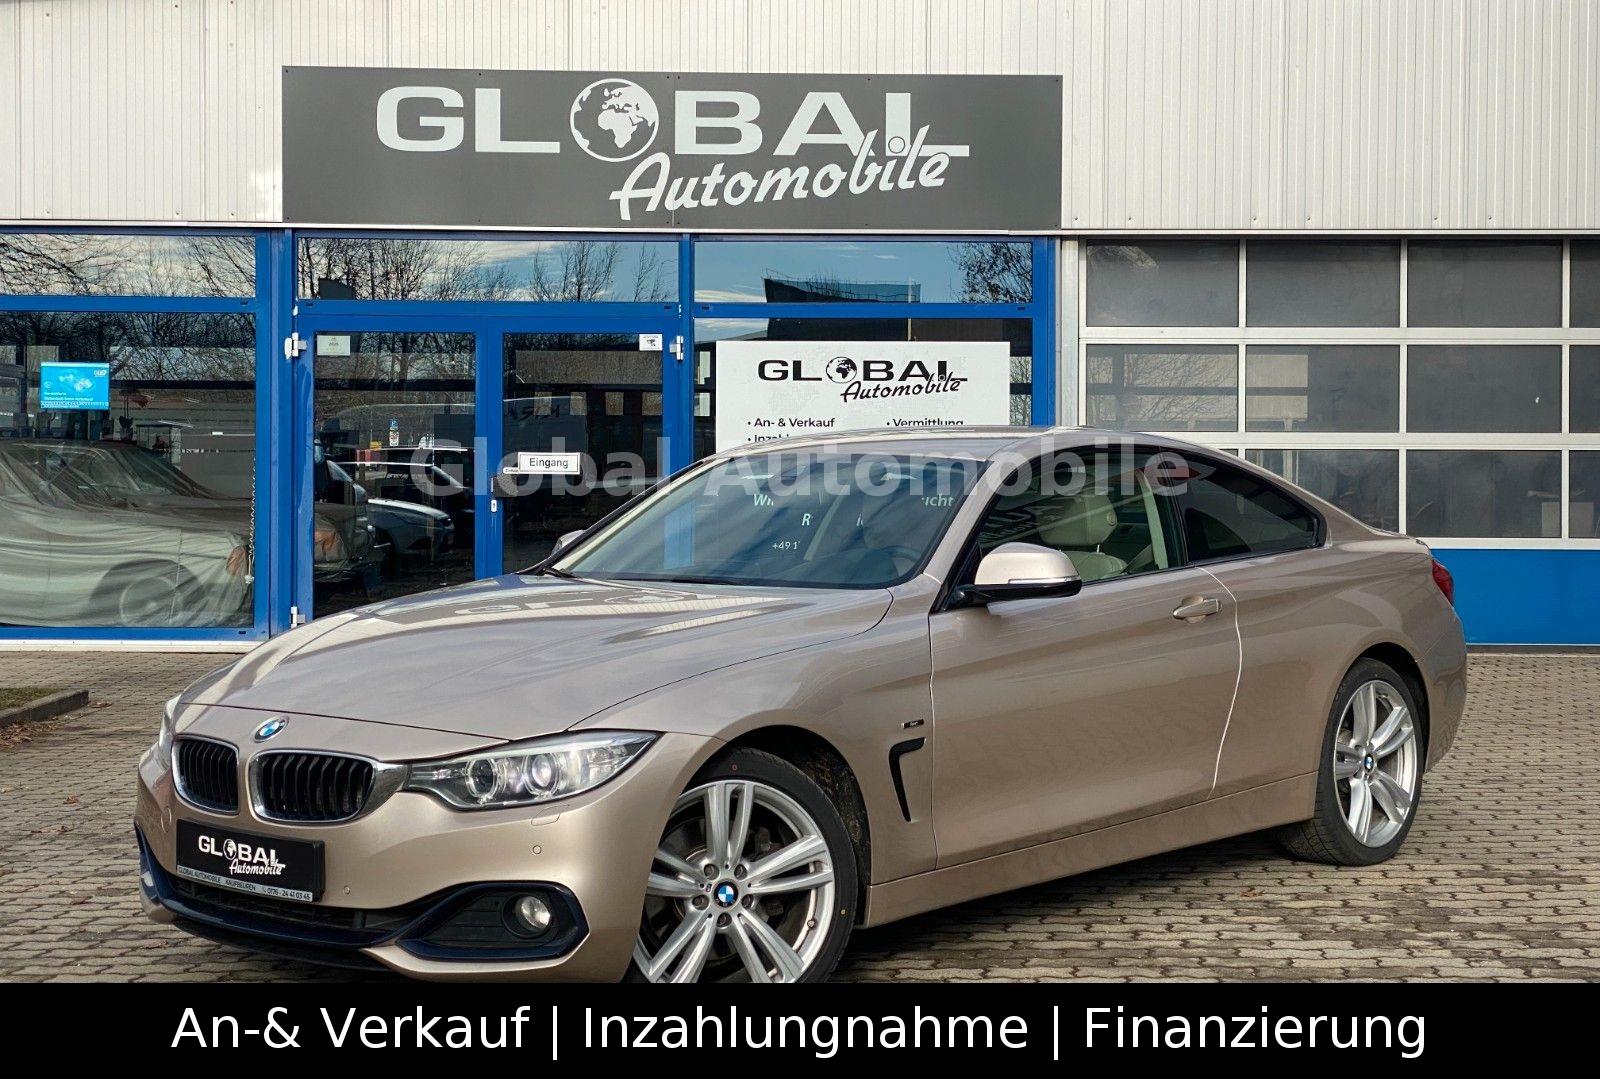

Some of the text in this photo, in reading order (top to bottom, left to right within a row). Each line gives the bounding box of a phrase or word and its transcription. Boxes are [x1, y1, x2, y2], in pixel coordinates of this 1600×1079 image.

[376, 79, 969, 162] GLOBAL
[609, 126, 950, 220] Automobile
[757, 356, 968, 383] GLOBAL
[839, 371, 961, 402] Automobile
[754, 417, 836, 428] An- & Verkauf
[529, 457, 569, 469] Eingang
[198, 835, 286, 868] GLOBAL
[229, 856, 283, 876] Automobile
